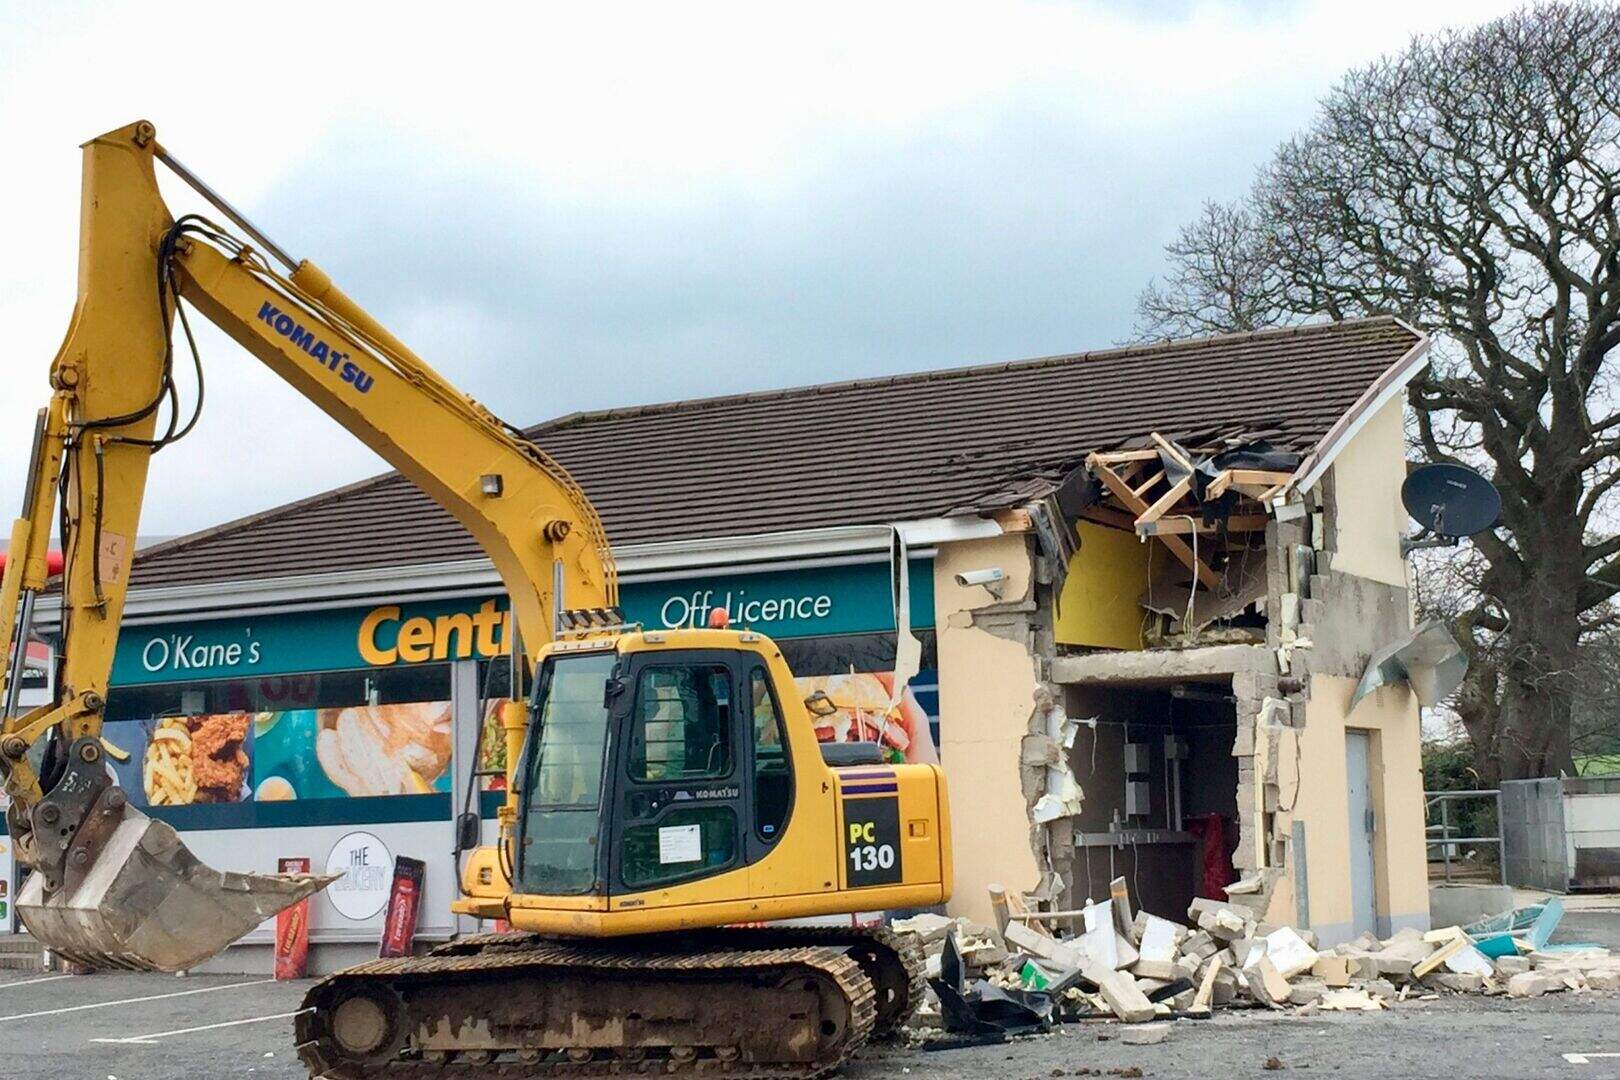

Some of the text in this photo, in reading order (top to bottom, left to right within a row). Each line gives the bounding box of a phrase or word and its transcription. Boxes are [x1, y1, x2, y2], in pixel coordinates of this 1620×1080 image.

[257, 300, 375, 394] KOMATSU
[661, 590, 832, 629] Off Licence
[142, 628, 261, 673] O'Kane's
[696, 787, 739, 799] KOMATSU
[850, 822, 876, 844] PC
[350, 846, 369, 866] THE
[850, 844, 895, 871] 130
